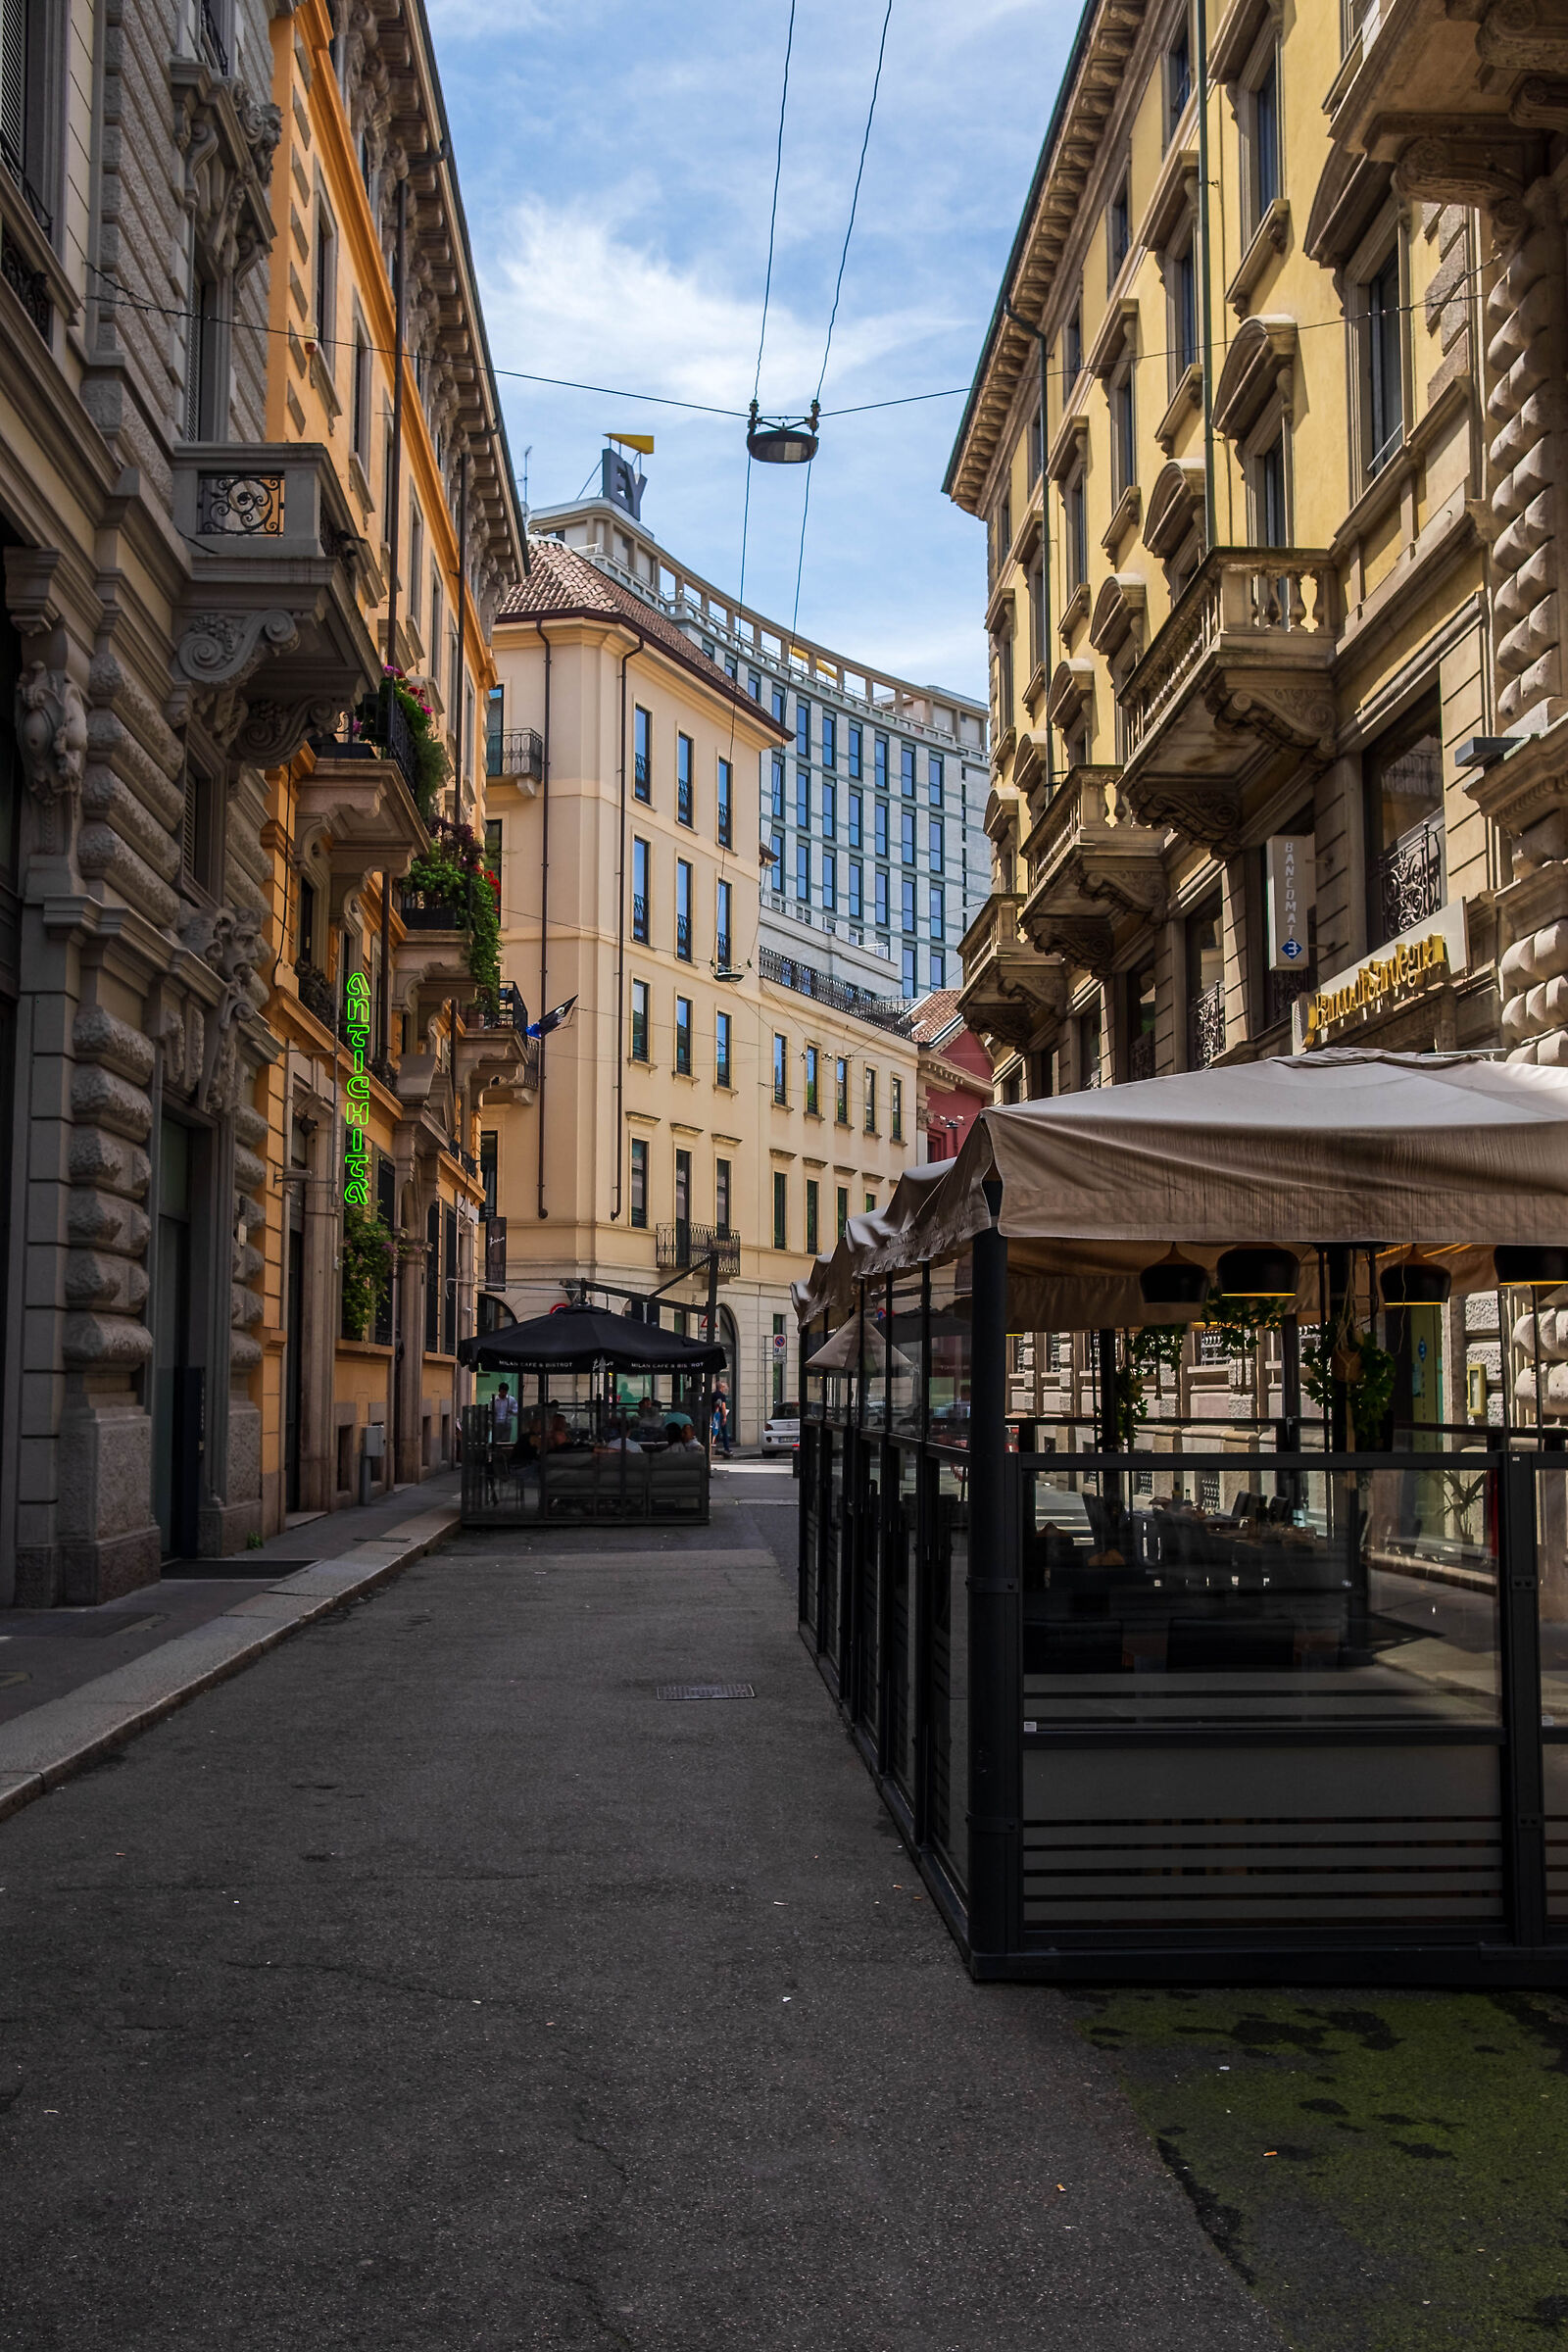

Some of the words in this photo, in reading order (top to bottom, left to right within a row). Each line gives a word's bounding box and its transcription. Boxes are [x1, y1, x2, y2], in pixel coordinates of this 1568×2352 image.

[602, 447, 648, 521] EY
[1285, 842, 1297, 936] BANCOMAT
[1315, 985, 1353, 1030] Banco
[1368, 934, 1445, 1001] Sardegna
